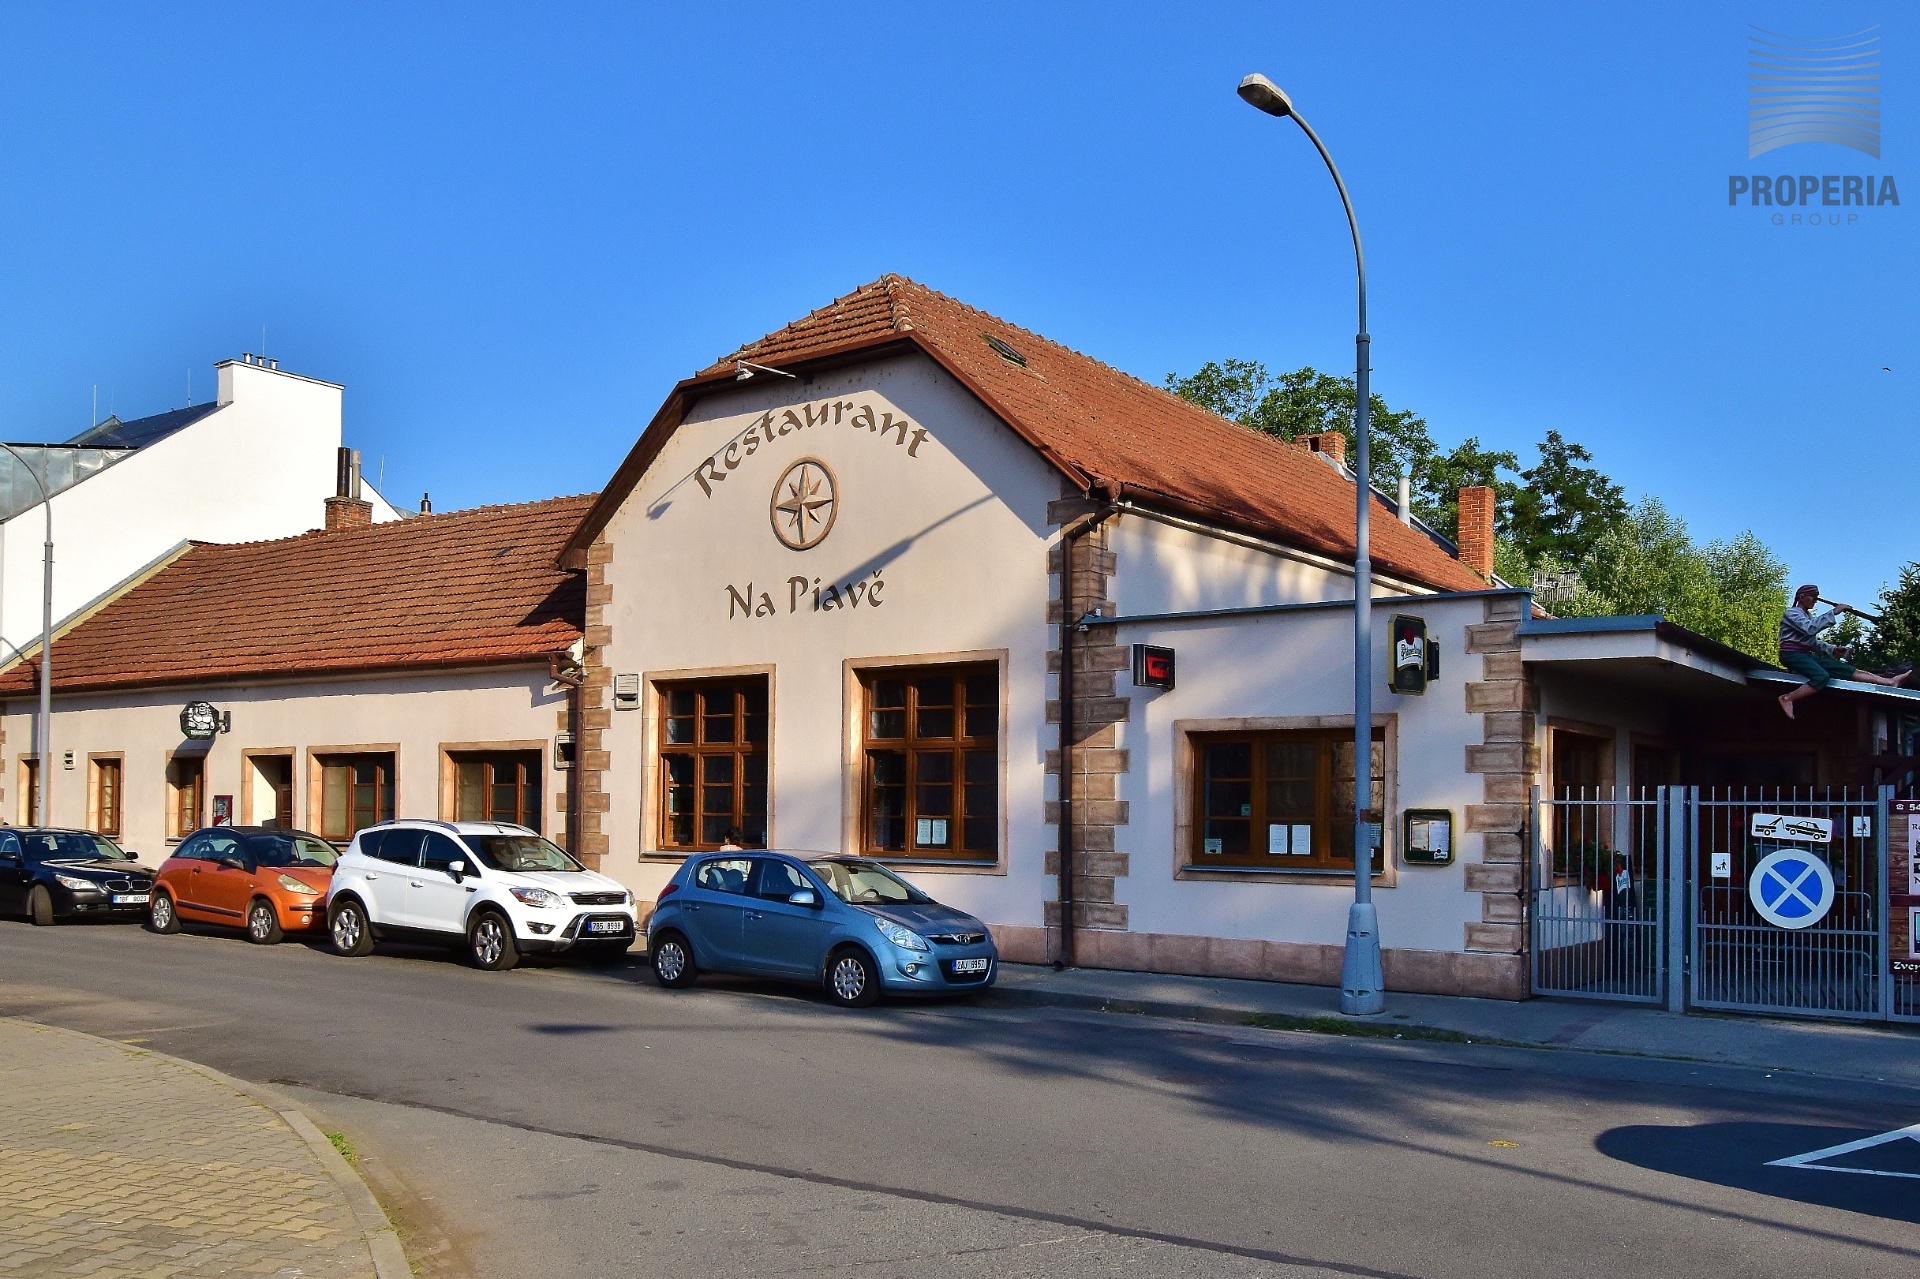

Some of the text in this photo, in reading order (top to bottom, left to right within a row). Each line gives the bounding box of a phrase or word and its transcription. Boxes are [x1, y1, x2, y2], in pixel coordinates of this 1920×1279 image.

[694, 400, 930, 498] Restaurant
[724, 570, 885, 620] Na Piavě
